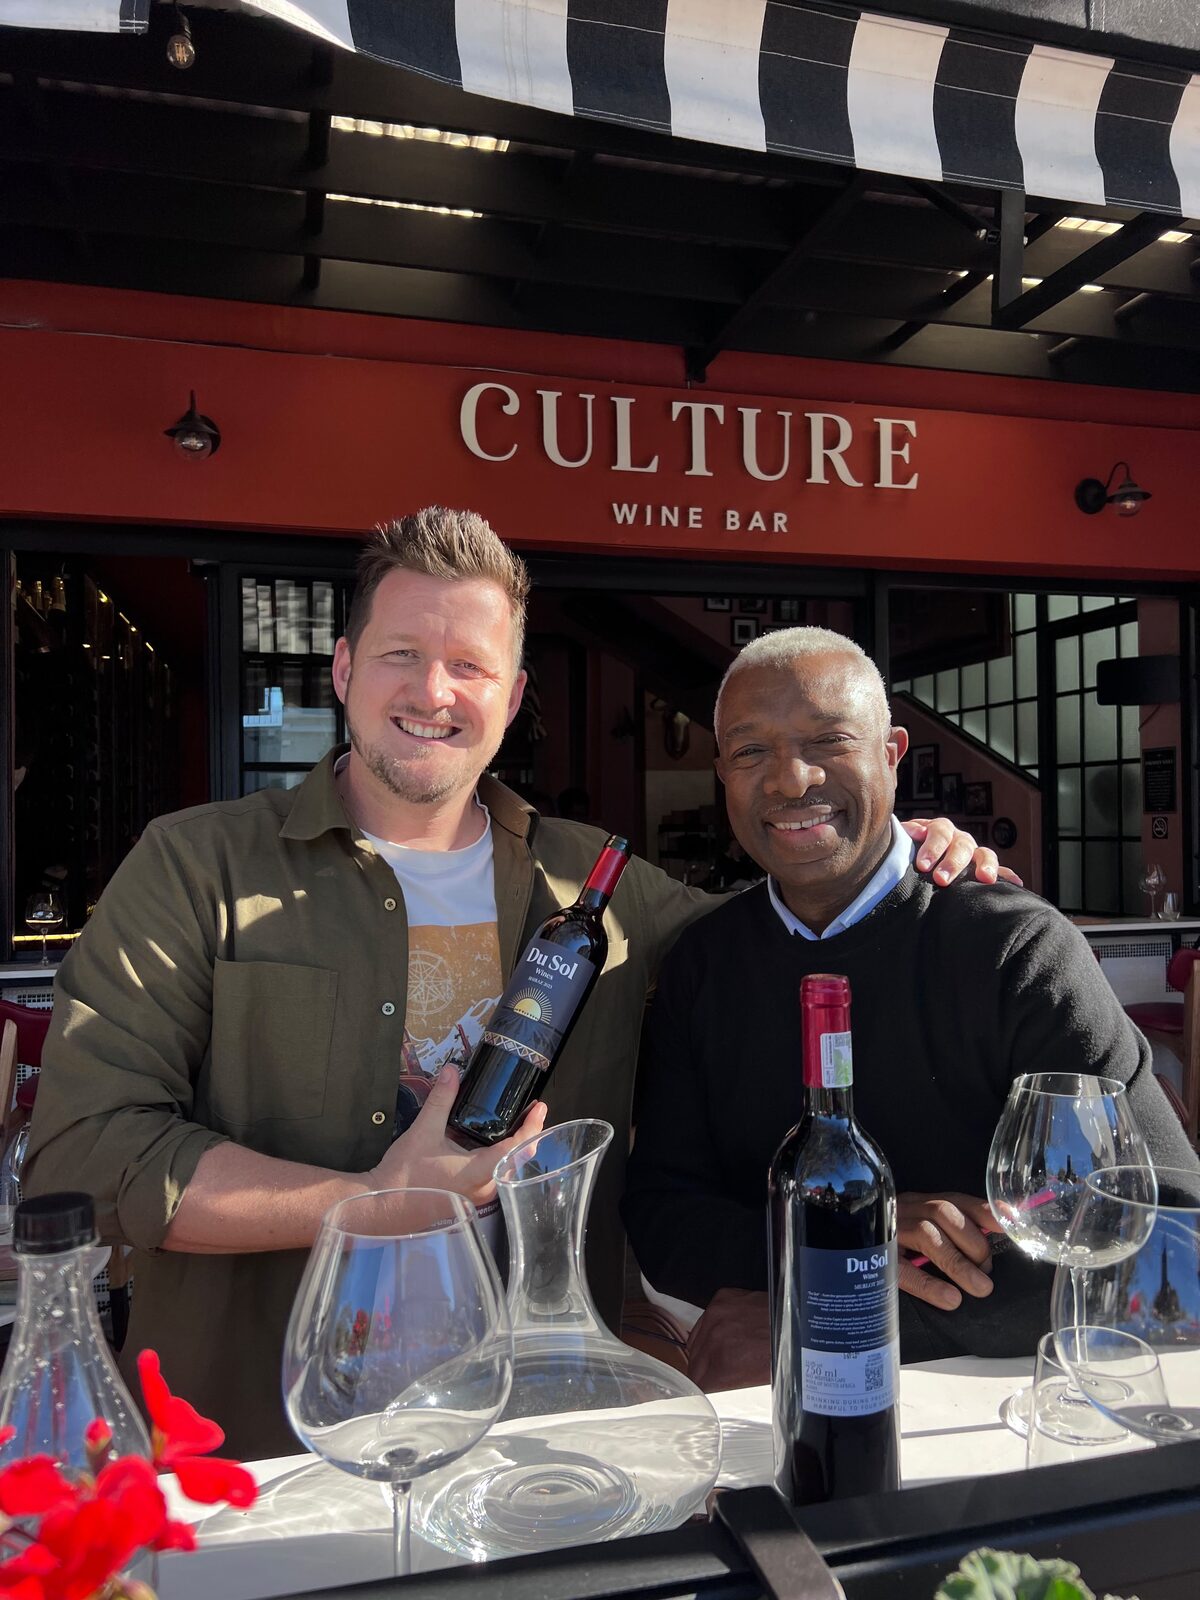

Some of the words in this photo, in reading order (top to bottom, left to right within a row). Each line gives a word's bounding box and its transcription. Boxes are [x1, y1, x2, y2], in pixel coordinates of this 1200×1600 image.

[459, 382, 919, 490] CULTURE
[612, 503, 703, 529] WINE
[726, 510, 789, 533] BAR
[526, 947, 549, 966] Du
[548, 954, 579, 980] Sol
[535, 967, 554, 981] Wines
[846, 1257, 869, 1274] Du
[870, 1249, 889, 1270] Sol
[862, 1272, 879, 1280] Wines
[805, 1366, 822, 1376] 750
[824, 1368, 838, 1378] ml
